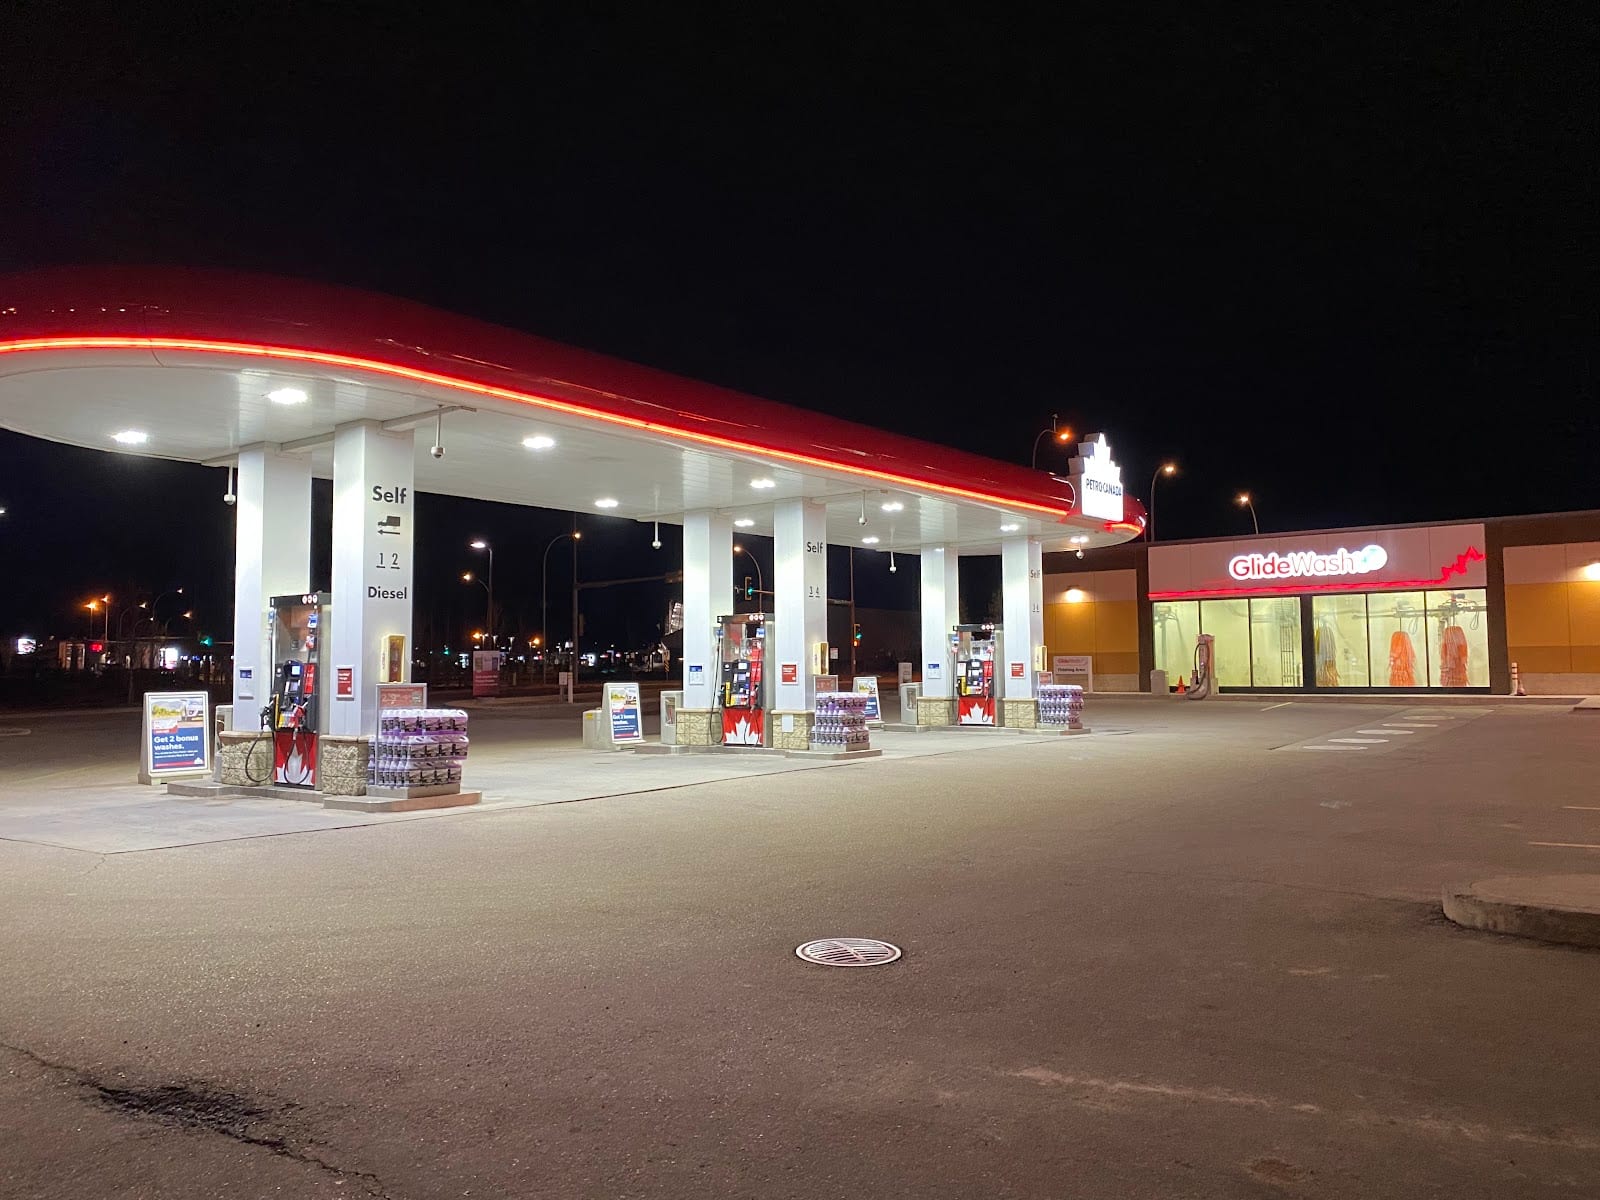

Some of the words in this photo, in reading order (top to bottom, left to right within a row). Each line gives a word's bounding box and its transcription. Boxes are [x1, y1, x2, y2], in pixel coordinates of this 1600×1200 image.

[372, 485, 407, 504] Self
[806, 541, 823, 554] Self
[392, 553, 399, 567] 2
[1232, 551, 1354, 577] GlideWash
[368, 586, 407, 600] Diesel
[154, 743, 185, 751] washes.
